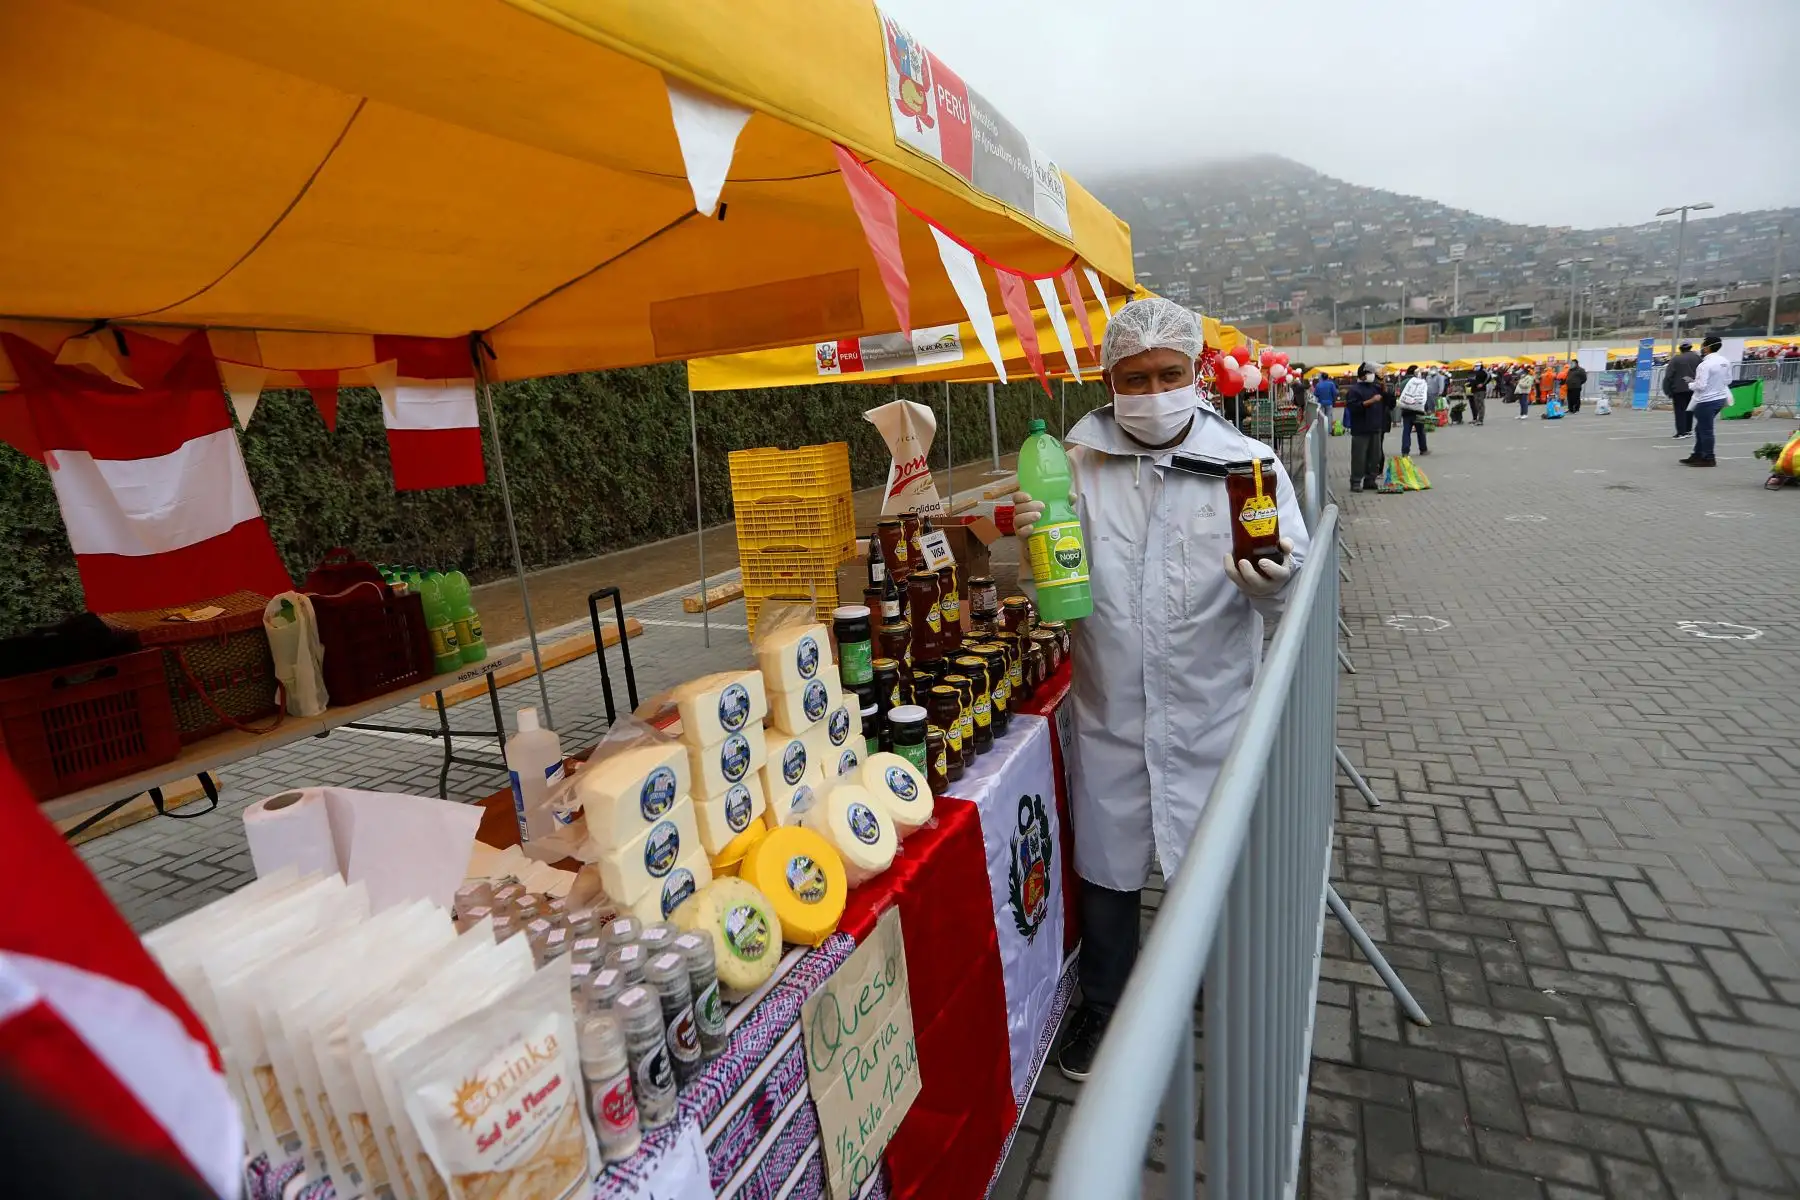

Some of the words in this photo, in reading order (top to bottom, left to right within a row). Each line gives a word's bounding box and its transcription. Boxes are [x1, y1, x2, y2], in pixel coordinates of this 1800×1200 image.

[937, 84, 967, 125] PERÚ
[839, 352, 859, 361] PERÚ
[908, 502, 941, 515] Calidad
[931, 546, 946, 559] VISA
[810, 955, 897, 1073] Queso
[842, 1021, 899, 1101] Paria
[476, 1121, 503, 1154] Sal
[505, 1108, 523, 1130] de
